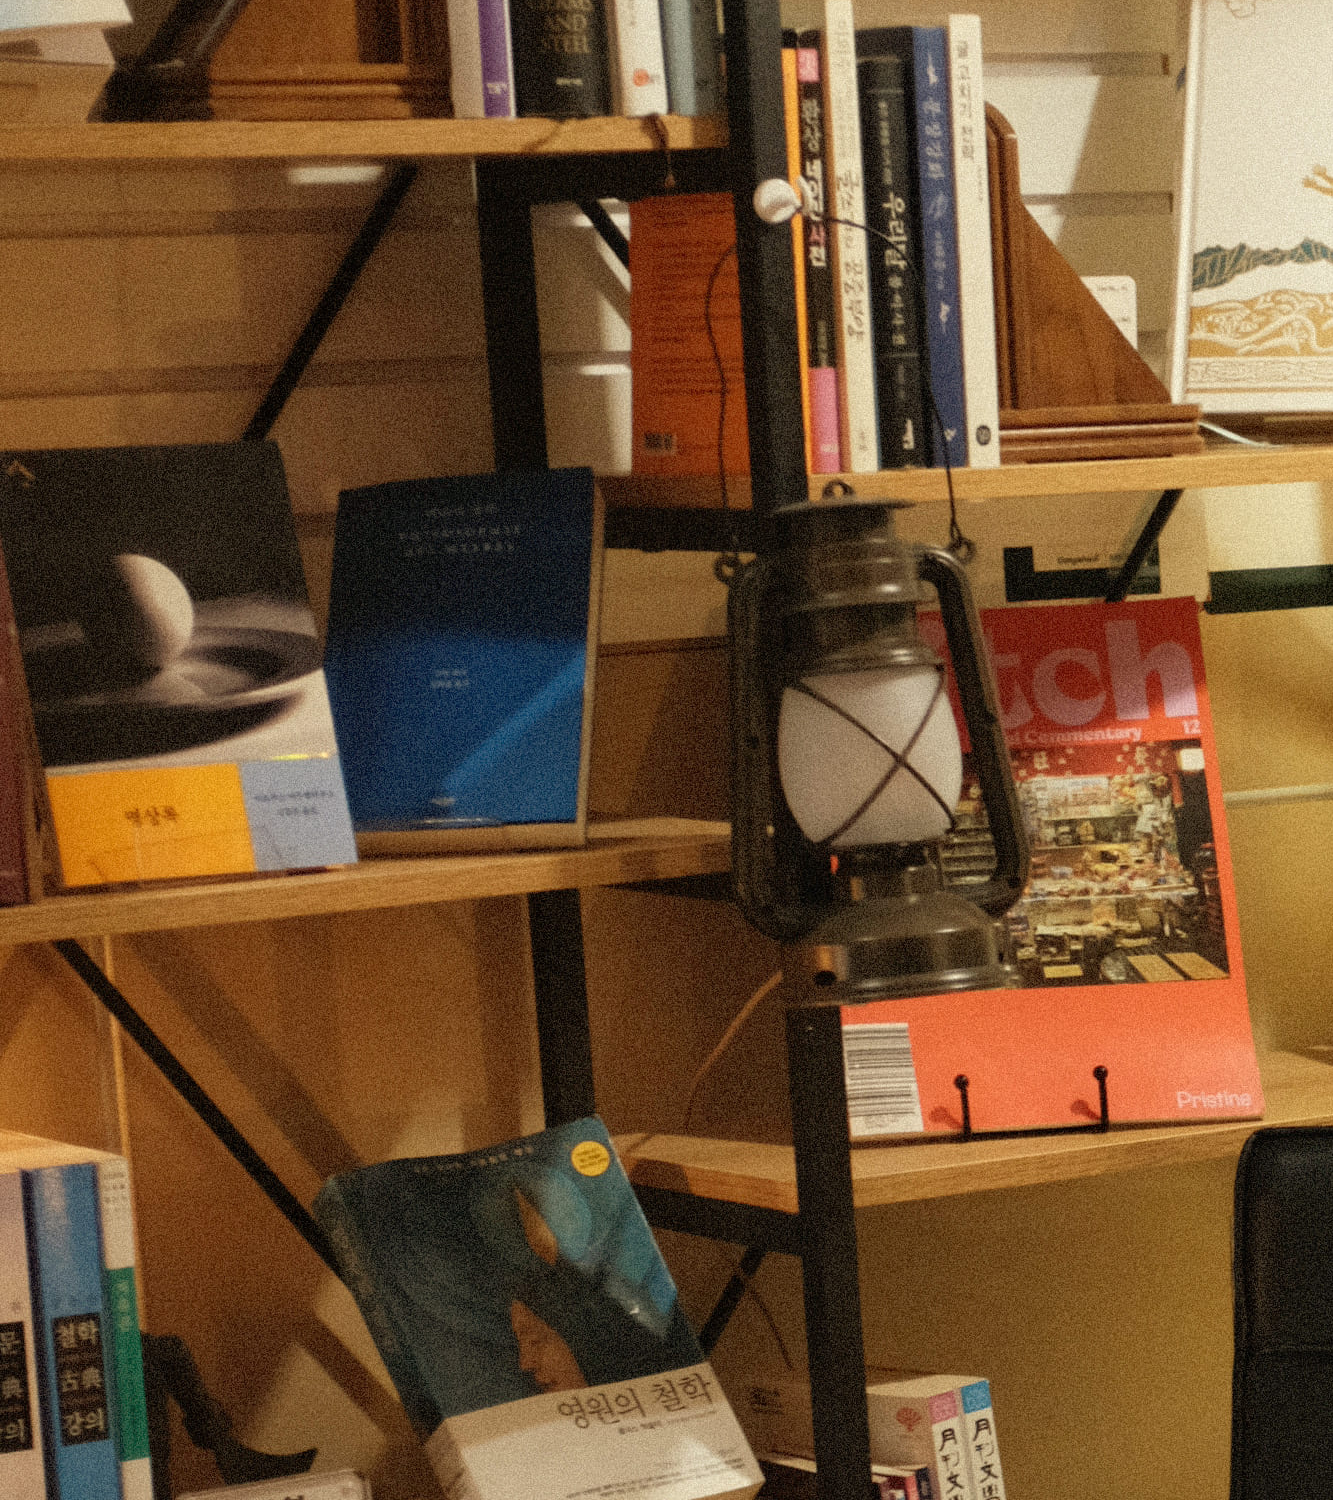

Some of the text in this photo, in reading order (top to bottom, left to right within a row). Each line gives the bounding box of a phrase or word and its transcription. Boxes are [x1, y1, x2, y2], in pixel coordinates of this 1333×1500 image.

[1181, 718, 1203, 736] 12
[1175, 1087, 1253, 1112] Pristine
[58, 1320, 101, 1349] 철학
[557, 1389, 645, 1431] 영원의
[650, 1372, 713, 1412] 철학
